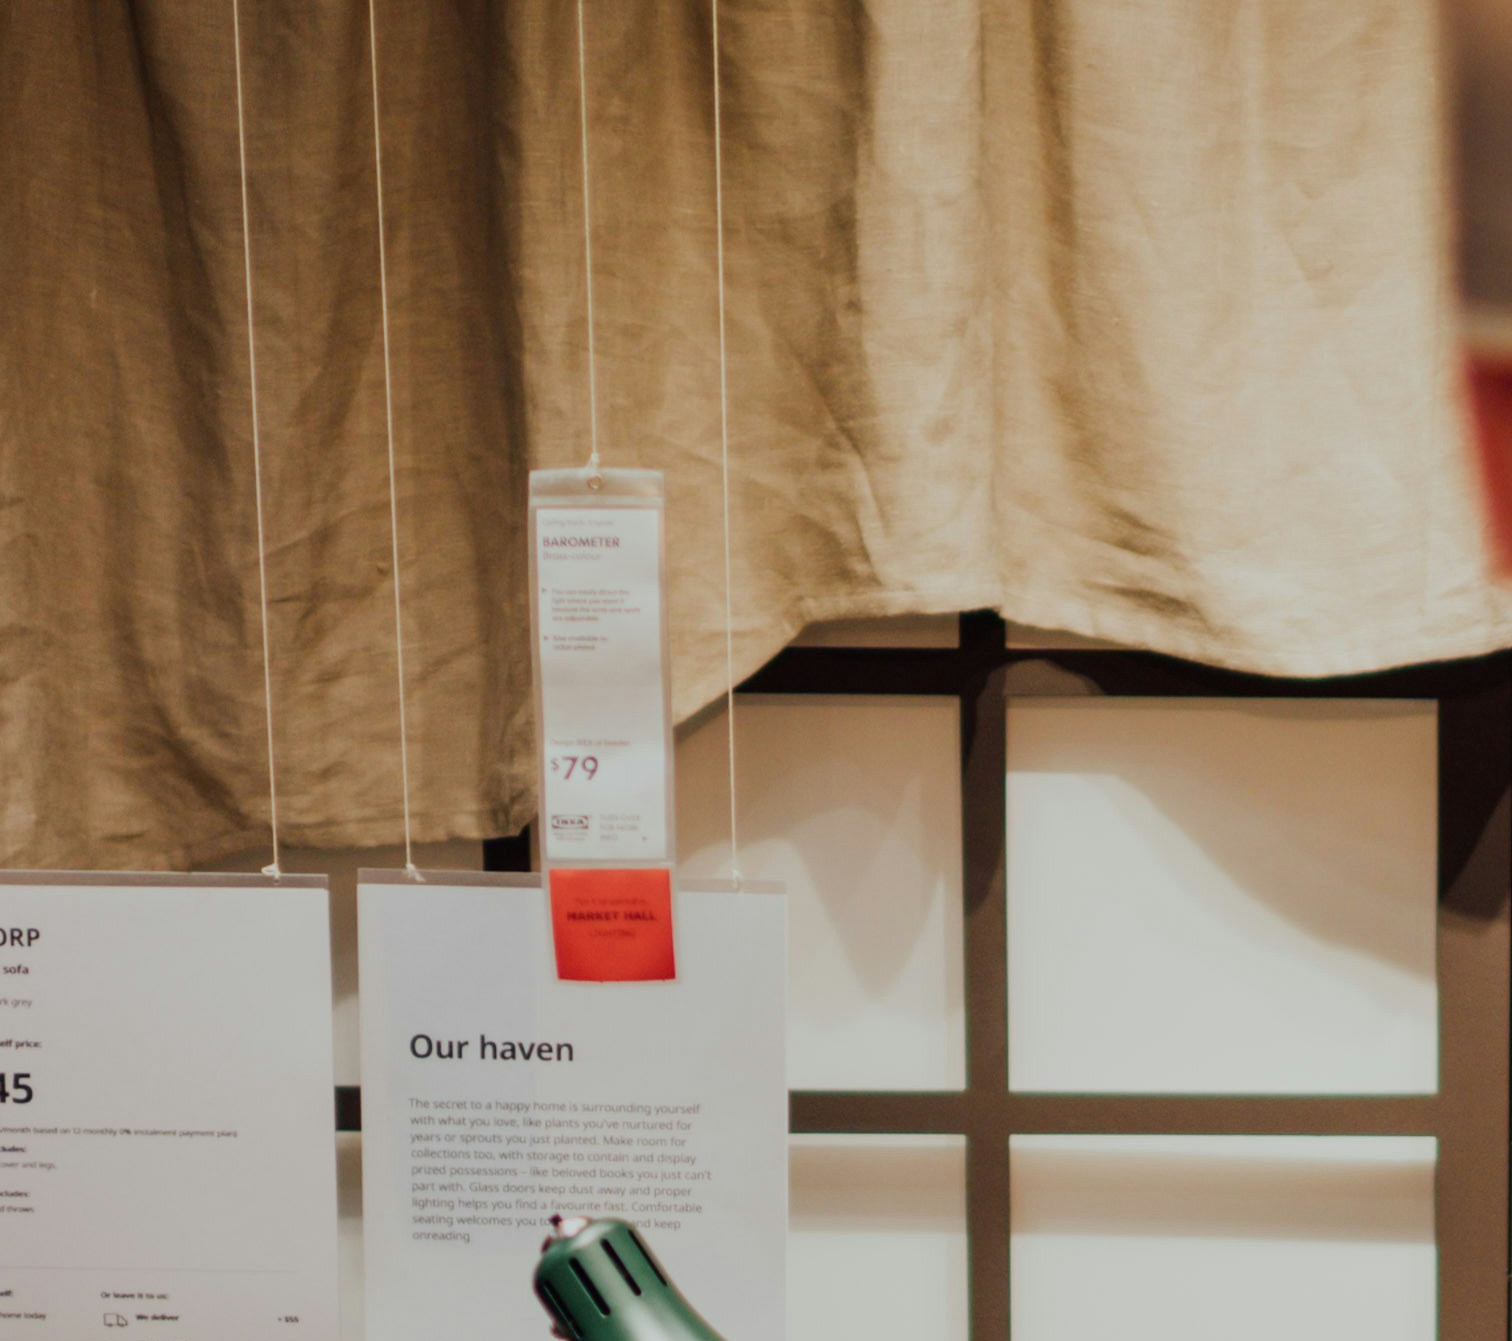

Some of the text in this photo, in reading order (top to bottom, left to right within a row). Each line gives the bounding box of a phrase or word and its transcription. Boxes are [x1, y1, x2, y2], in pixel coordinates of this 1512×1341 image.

[543, 536, 621, 548] BAROMETER
[551, 756, 599, 781] $79
[567, 911, 656, 922] MARKET HALL
[2, 963, 29, 975] sofa
[12, 1000, 32, 1009] grey
[14, 1039, 42, 1050] price:
[410, 1034, 574, 1061] Our haven
[409, 1098, 700, 1116] The secret to a happy home is surrounding yourself
[410, 1115, 692, 1131] with what you love, like plants you've nurtured for
[409, 1133, 687, 1147] years or sprouts you just planted. Make room for
[411, 1148, 696, 1166] collections too, with storage to contain and display
[411, 1164, 712, 1182] prized possessions like beloved books you just can't
[412, 1181, 691, 1199] part with. Glass doors keep dust away and proper
[6, 1205, 34, 1213] throws
[412, 1197, 702, 1213] lighting helps you find a favourite fast. Comfortable
[412, 1214, 454, 1228] seating
[457, 1215, 513, 1226] welcomes
[516, 1218, 537, 1229] you
[635, 1217, 651, 1229] nd
[655, 1217, 681, 1231] keep
[412, 1230, 471, 1244] onreading
[24, 1312, 46, 1321] today
[136, 1313, 179, 1321] We deliver
